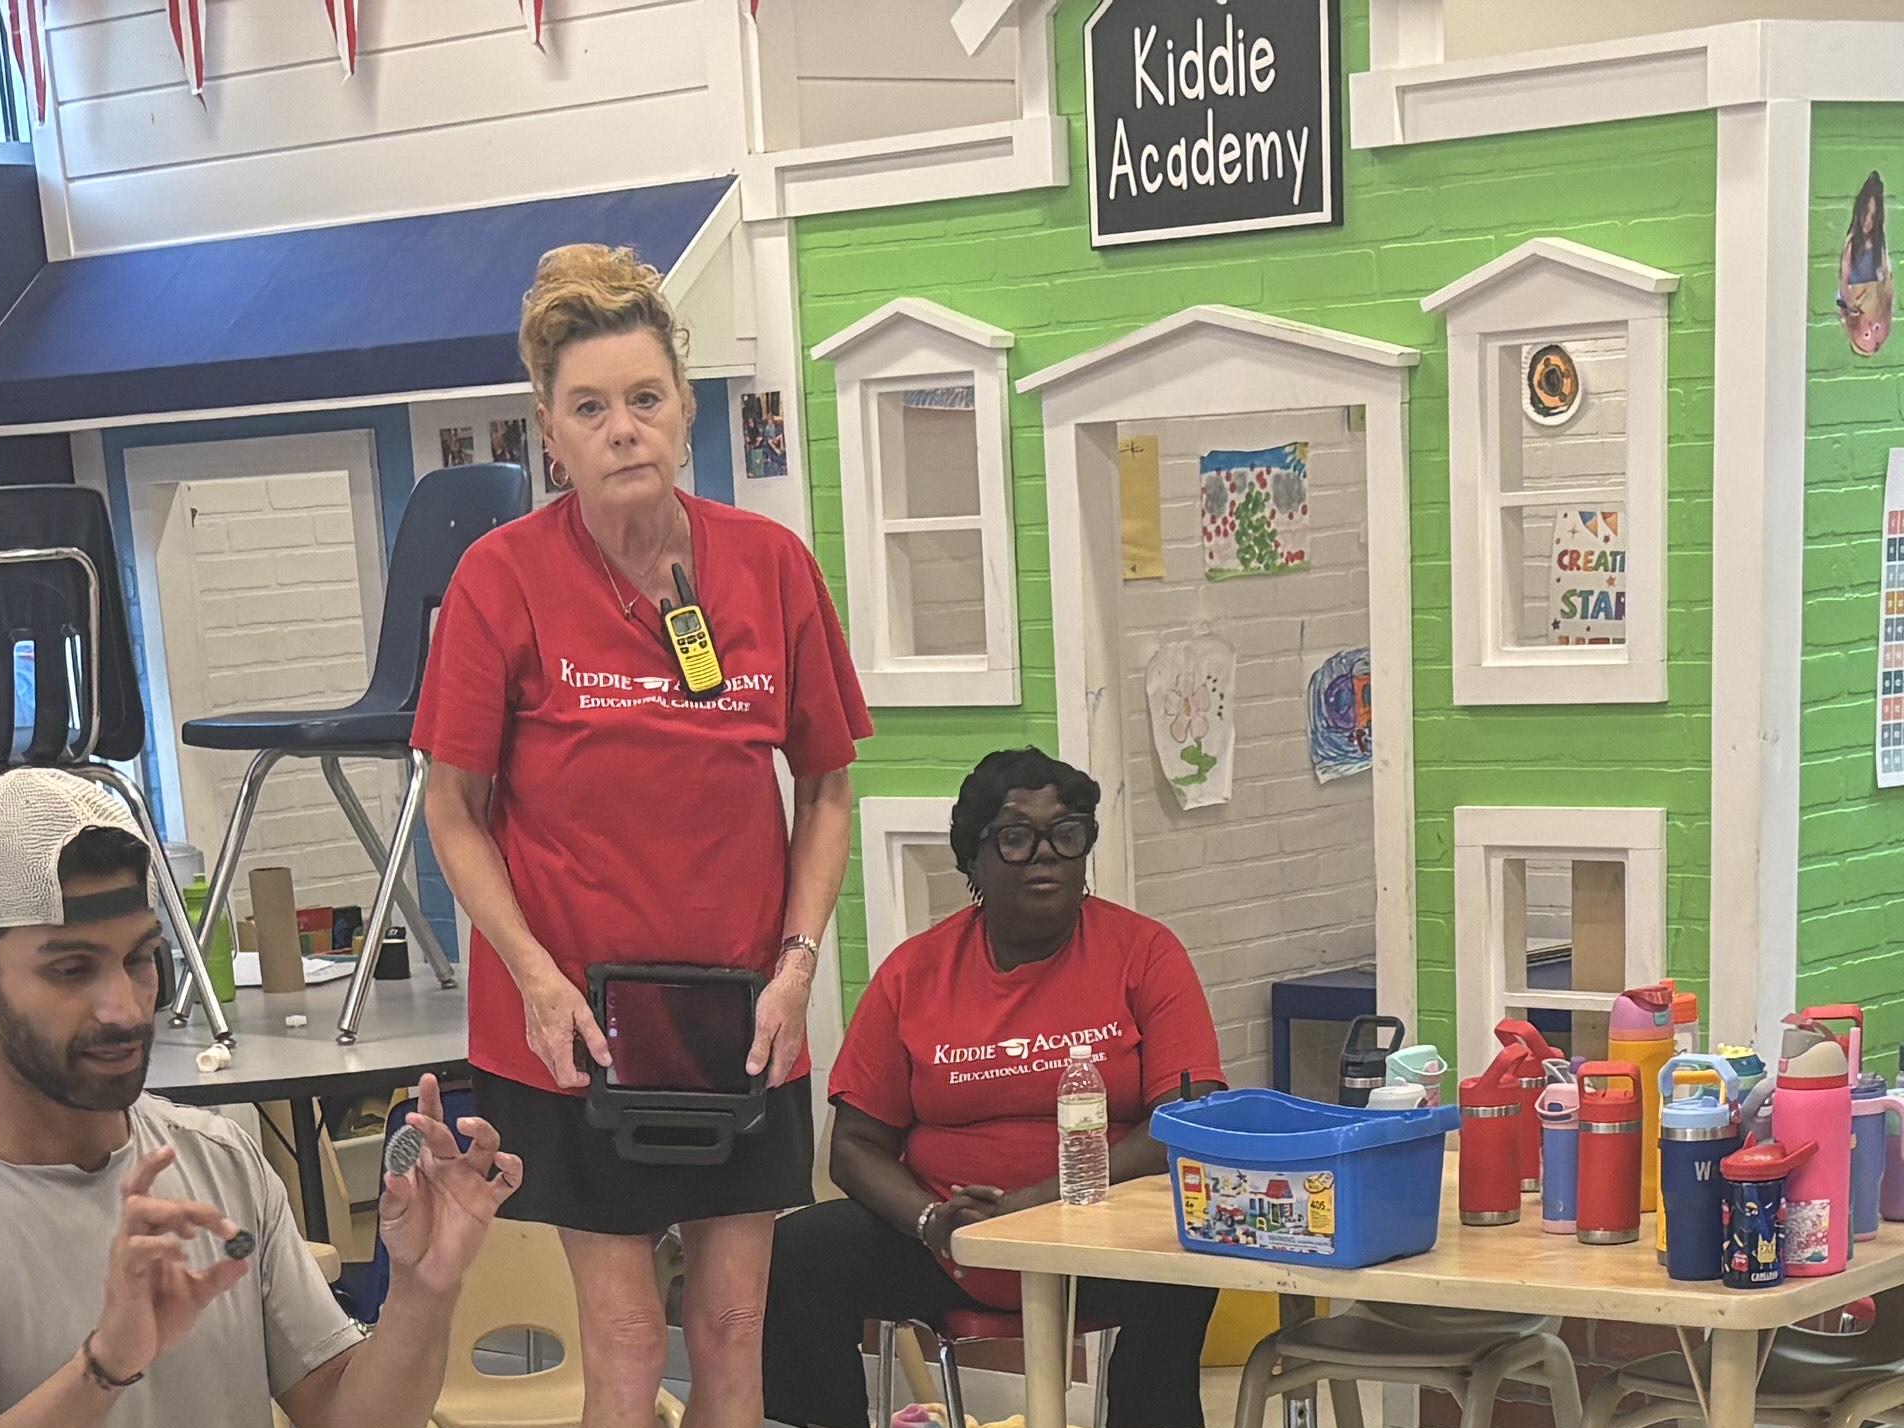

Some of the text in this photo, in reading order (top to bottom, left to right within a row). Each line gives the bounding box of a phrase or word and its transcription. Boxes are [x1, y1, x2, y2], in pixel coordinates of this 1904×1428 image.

[1134, 13, 1276, 109] Kiddie
[1109, 108, 1309, 206] Academy
[560, 658, 633, 690] KIDDIE
[717, 697, 751, 712] CARE
[933, 1021, 1119, 1065] KIDDIE ACADEMY
[949, 1064, 1032, 1084] EDUCATIONAL
